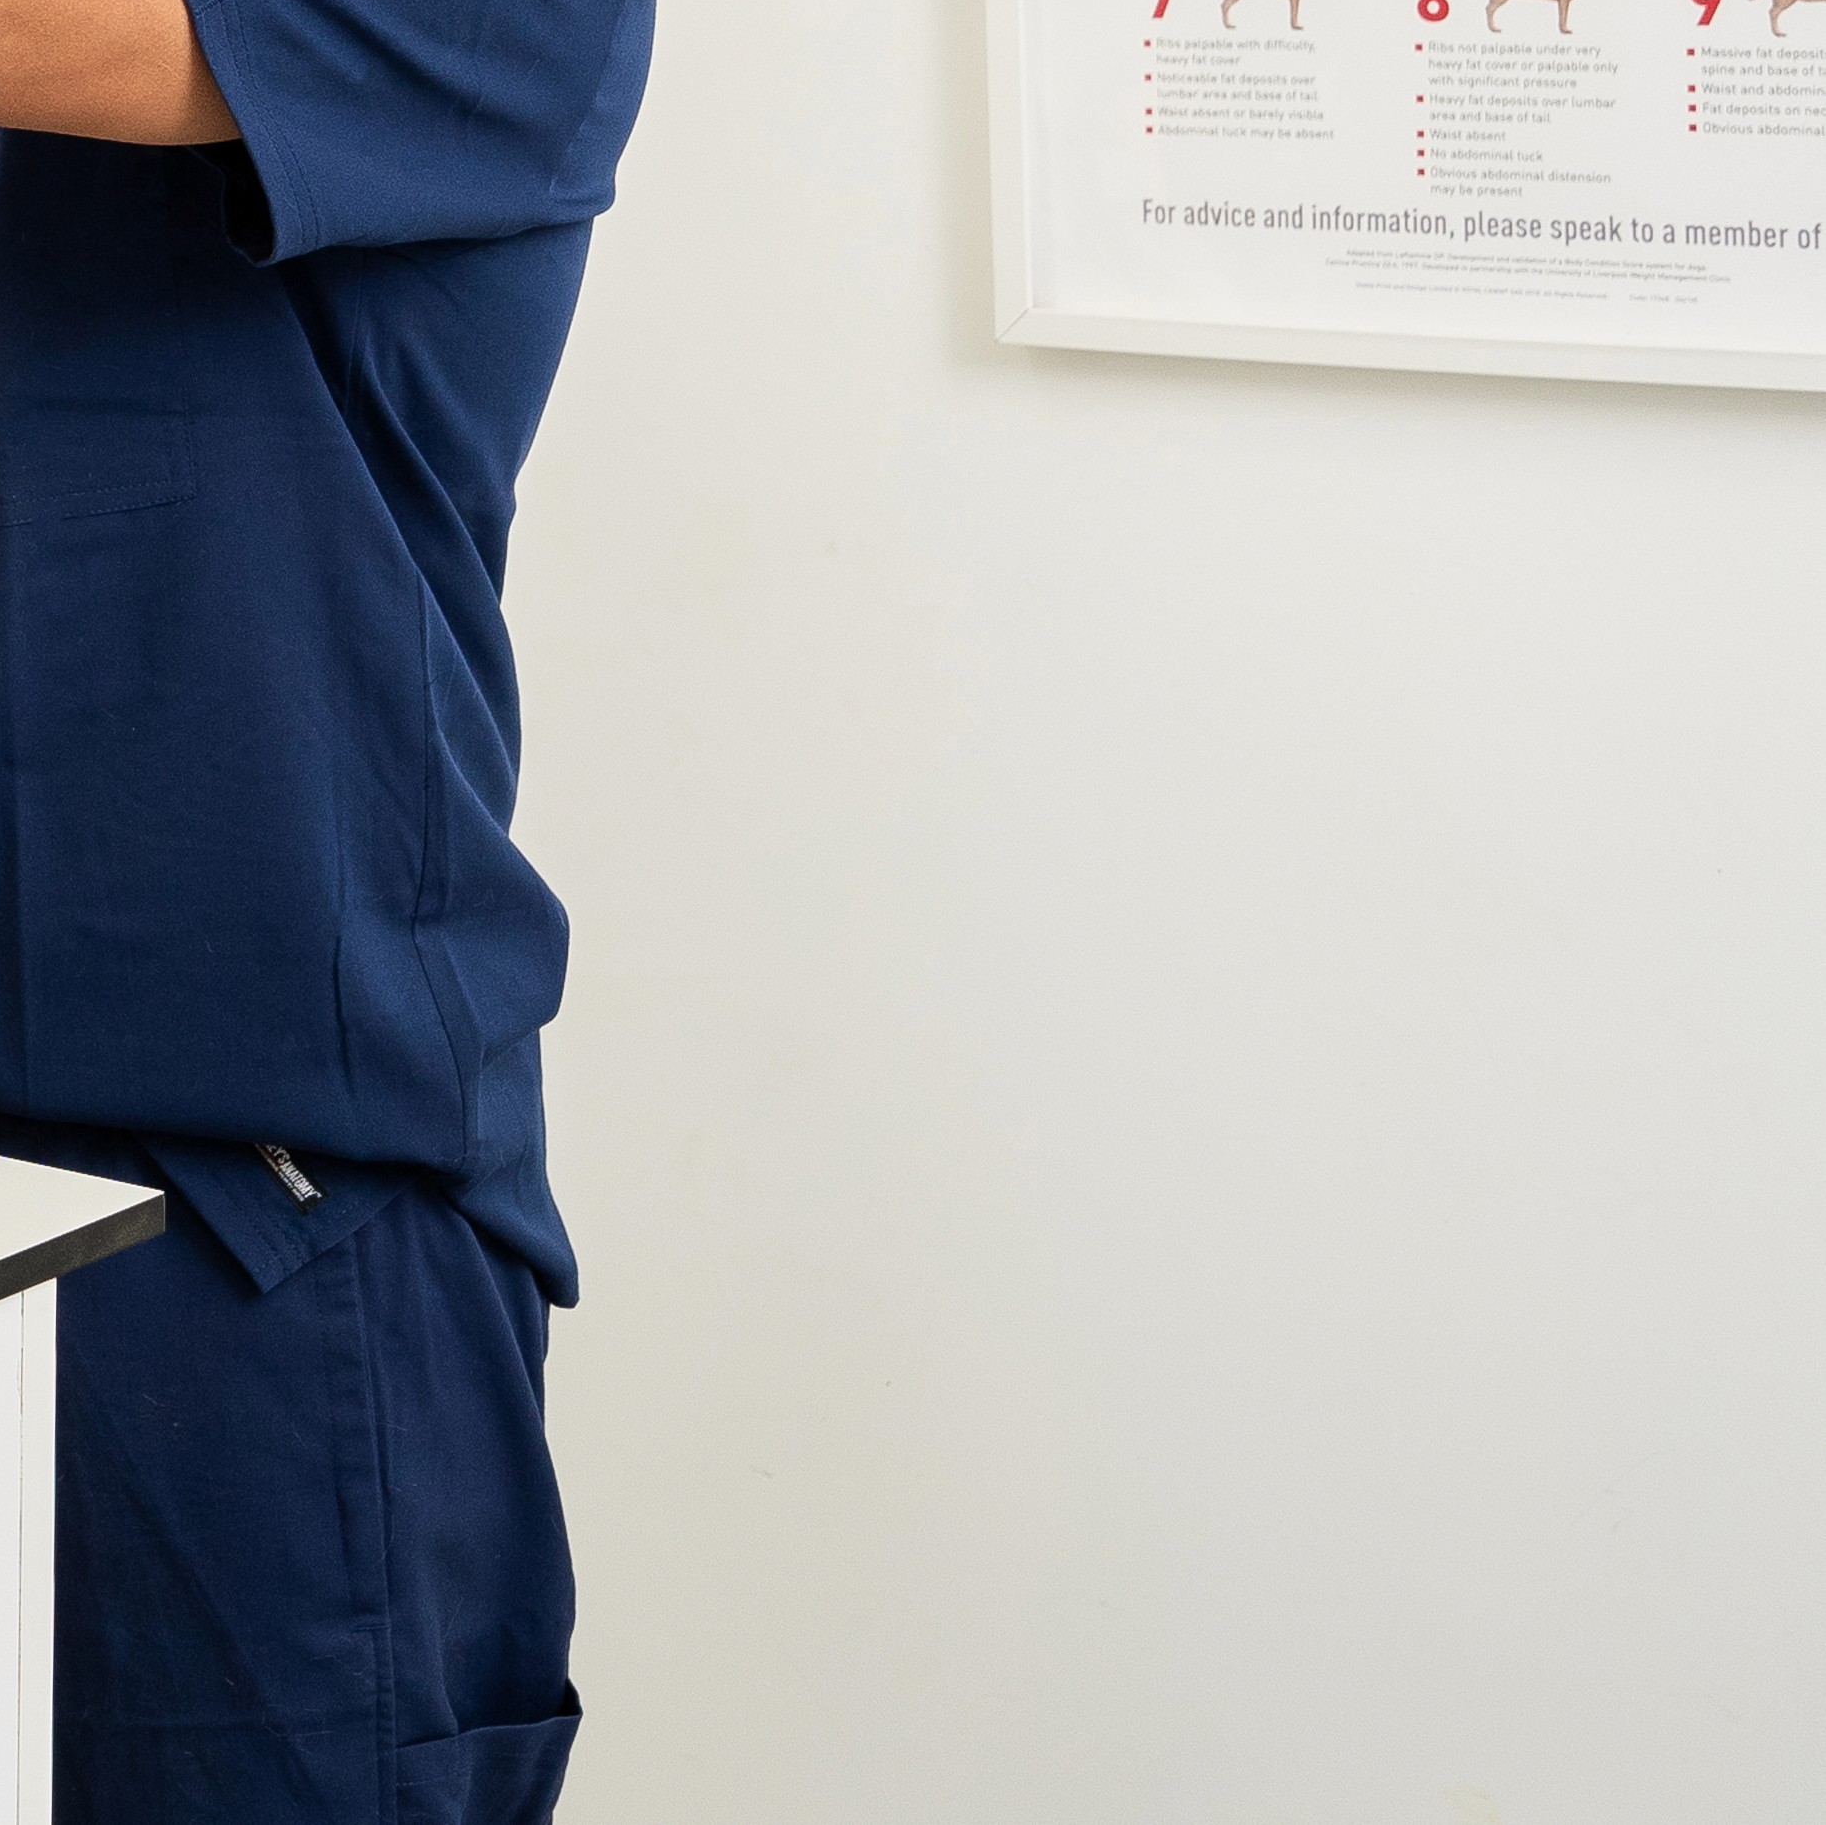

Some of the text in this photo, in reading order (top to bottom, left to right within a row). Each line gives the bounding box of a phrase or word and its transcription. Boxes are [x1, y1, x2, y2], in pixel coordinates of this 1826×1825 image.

[1701, 45, 1752, 58] Massive
[1756, 46, 1773, 58] fat
[1701, 62, 1736, 77] spine
[1739, 63, 1764, 75] and
[1767, 63, 1799, 75] base
[1802, 63, 1815, 75] of
[1701, 82, 1737, 94] Waist
[1741, 82, 1765, 94] and
[1702, 101, 1722, 114] Fat
[1726, 102, 1781, 118] deposits
[1784, 106, 1801, 115] on
[1703, 121, 1753, 134] Obvious
[1143, 200, 1821, 249] For advice and information, please speak to a member of
